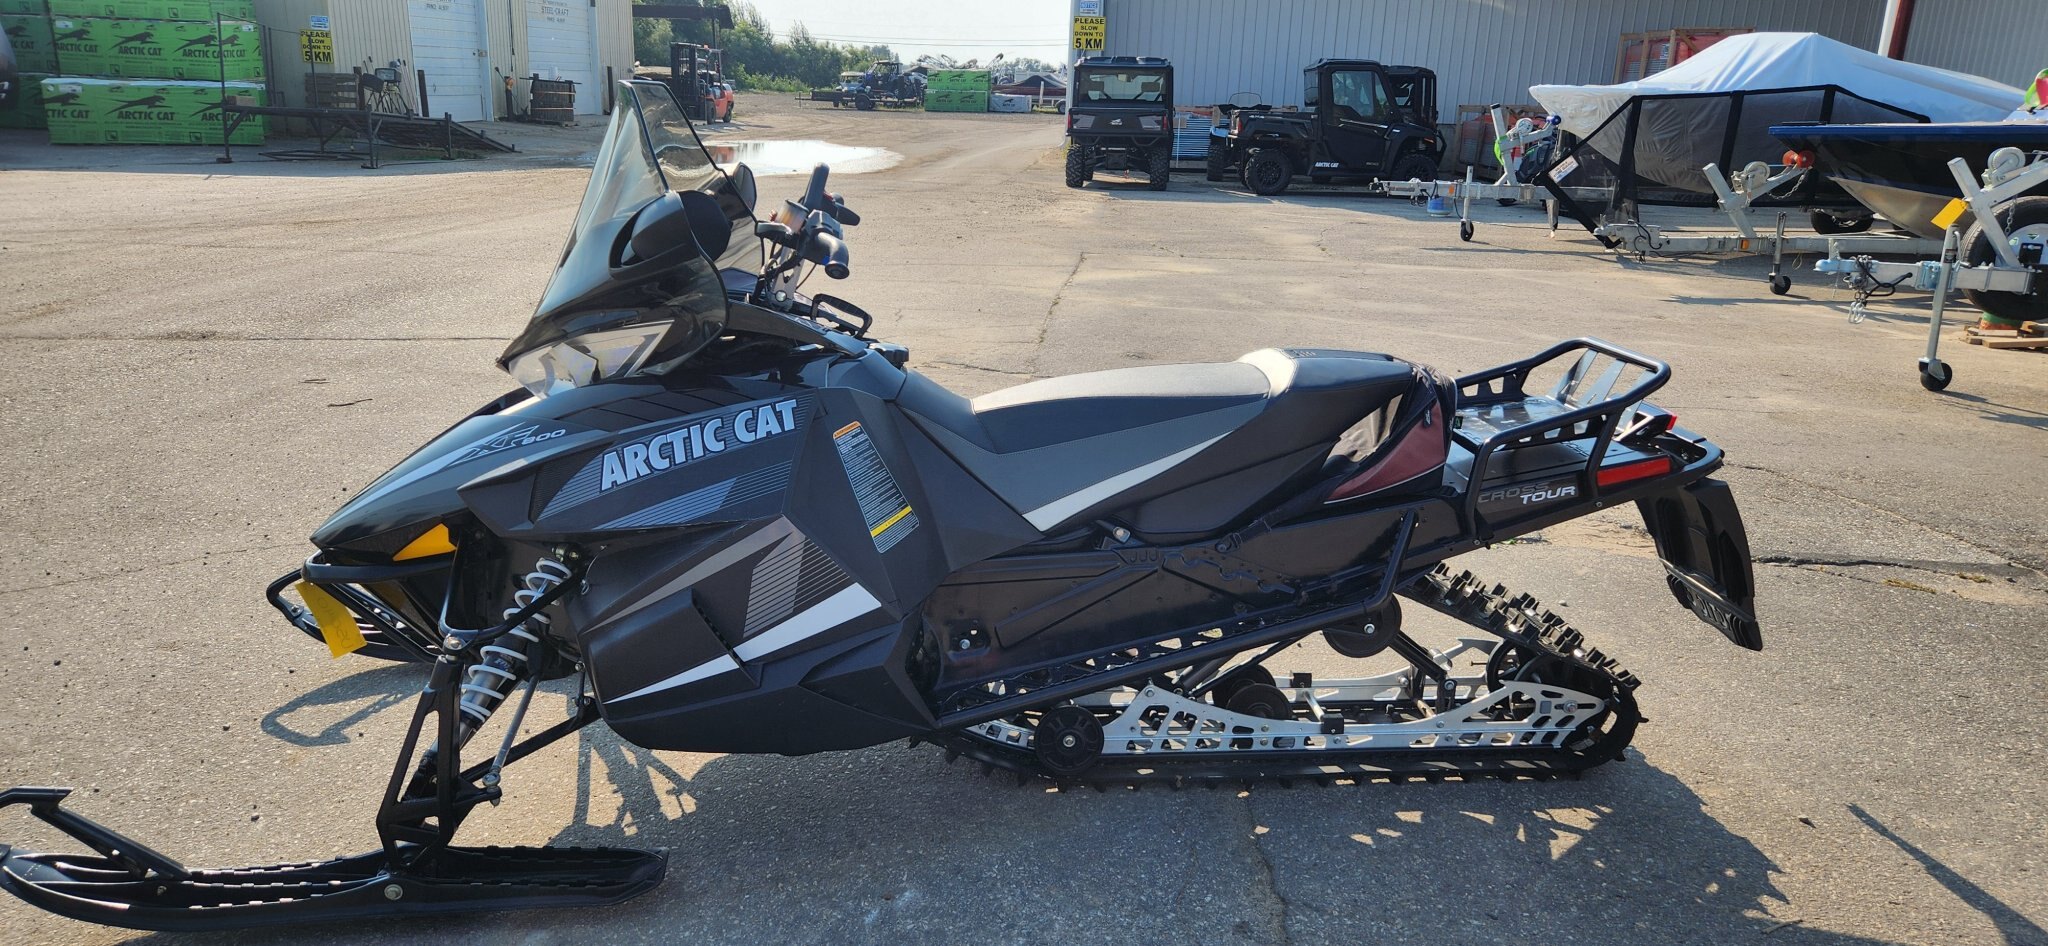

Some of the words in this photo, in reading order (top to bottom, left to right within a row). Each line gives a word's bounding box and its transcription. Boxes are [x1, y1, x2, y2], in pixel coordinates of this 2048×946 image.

[1074, 17, 1105, 25] PLEASE
[1075, 37, 1082, 49] 5
[1085, 38, 1102, 49] KM
[84, 44, 98, 53] CAT
[118, 45, 146, 55] ARCTIC
[147, 47, 162, 56] CAT
[182, 49, 210, 58] ARCTIC
[236, 49, 246, 58] CAT
[304, 50, 311, 61] 5
[314, 51, 332, 62] KM
[71, 109, 90, 119] CAT
[117, 111, 153, 120] ARCTIC
[157, 111, 175, 121] CAT
[201, 112, 236, 122] ARCIC
[521, 428, 566, 445] 800
[601, 417, 726, 492] ARCTIC
[733, 398, 798, 444] CAT
[1478, 480, 1549, 503] CROSS
[1519, 485, 1576, 505] TOUR
